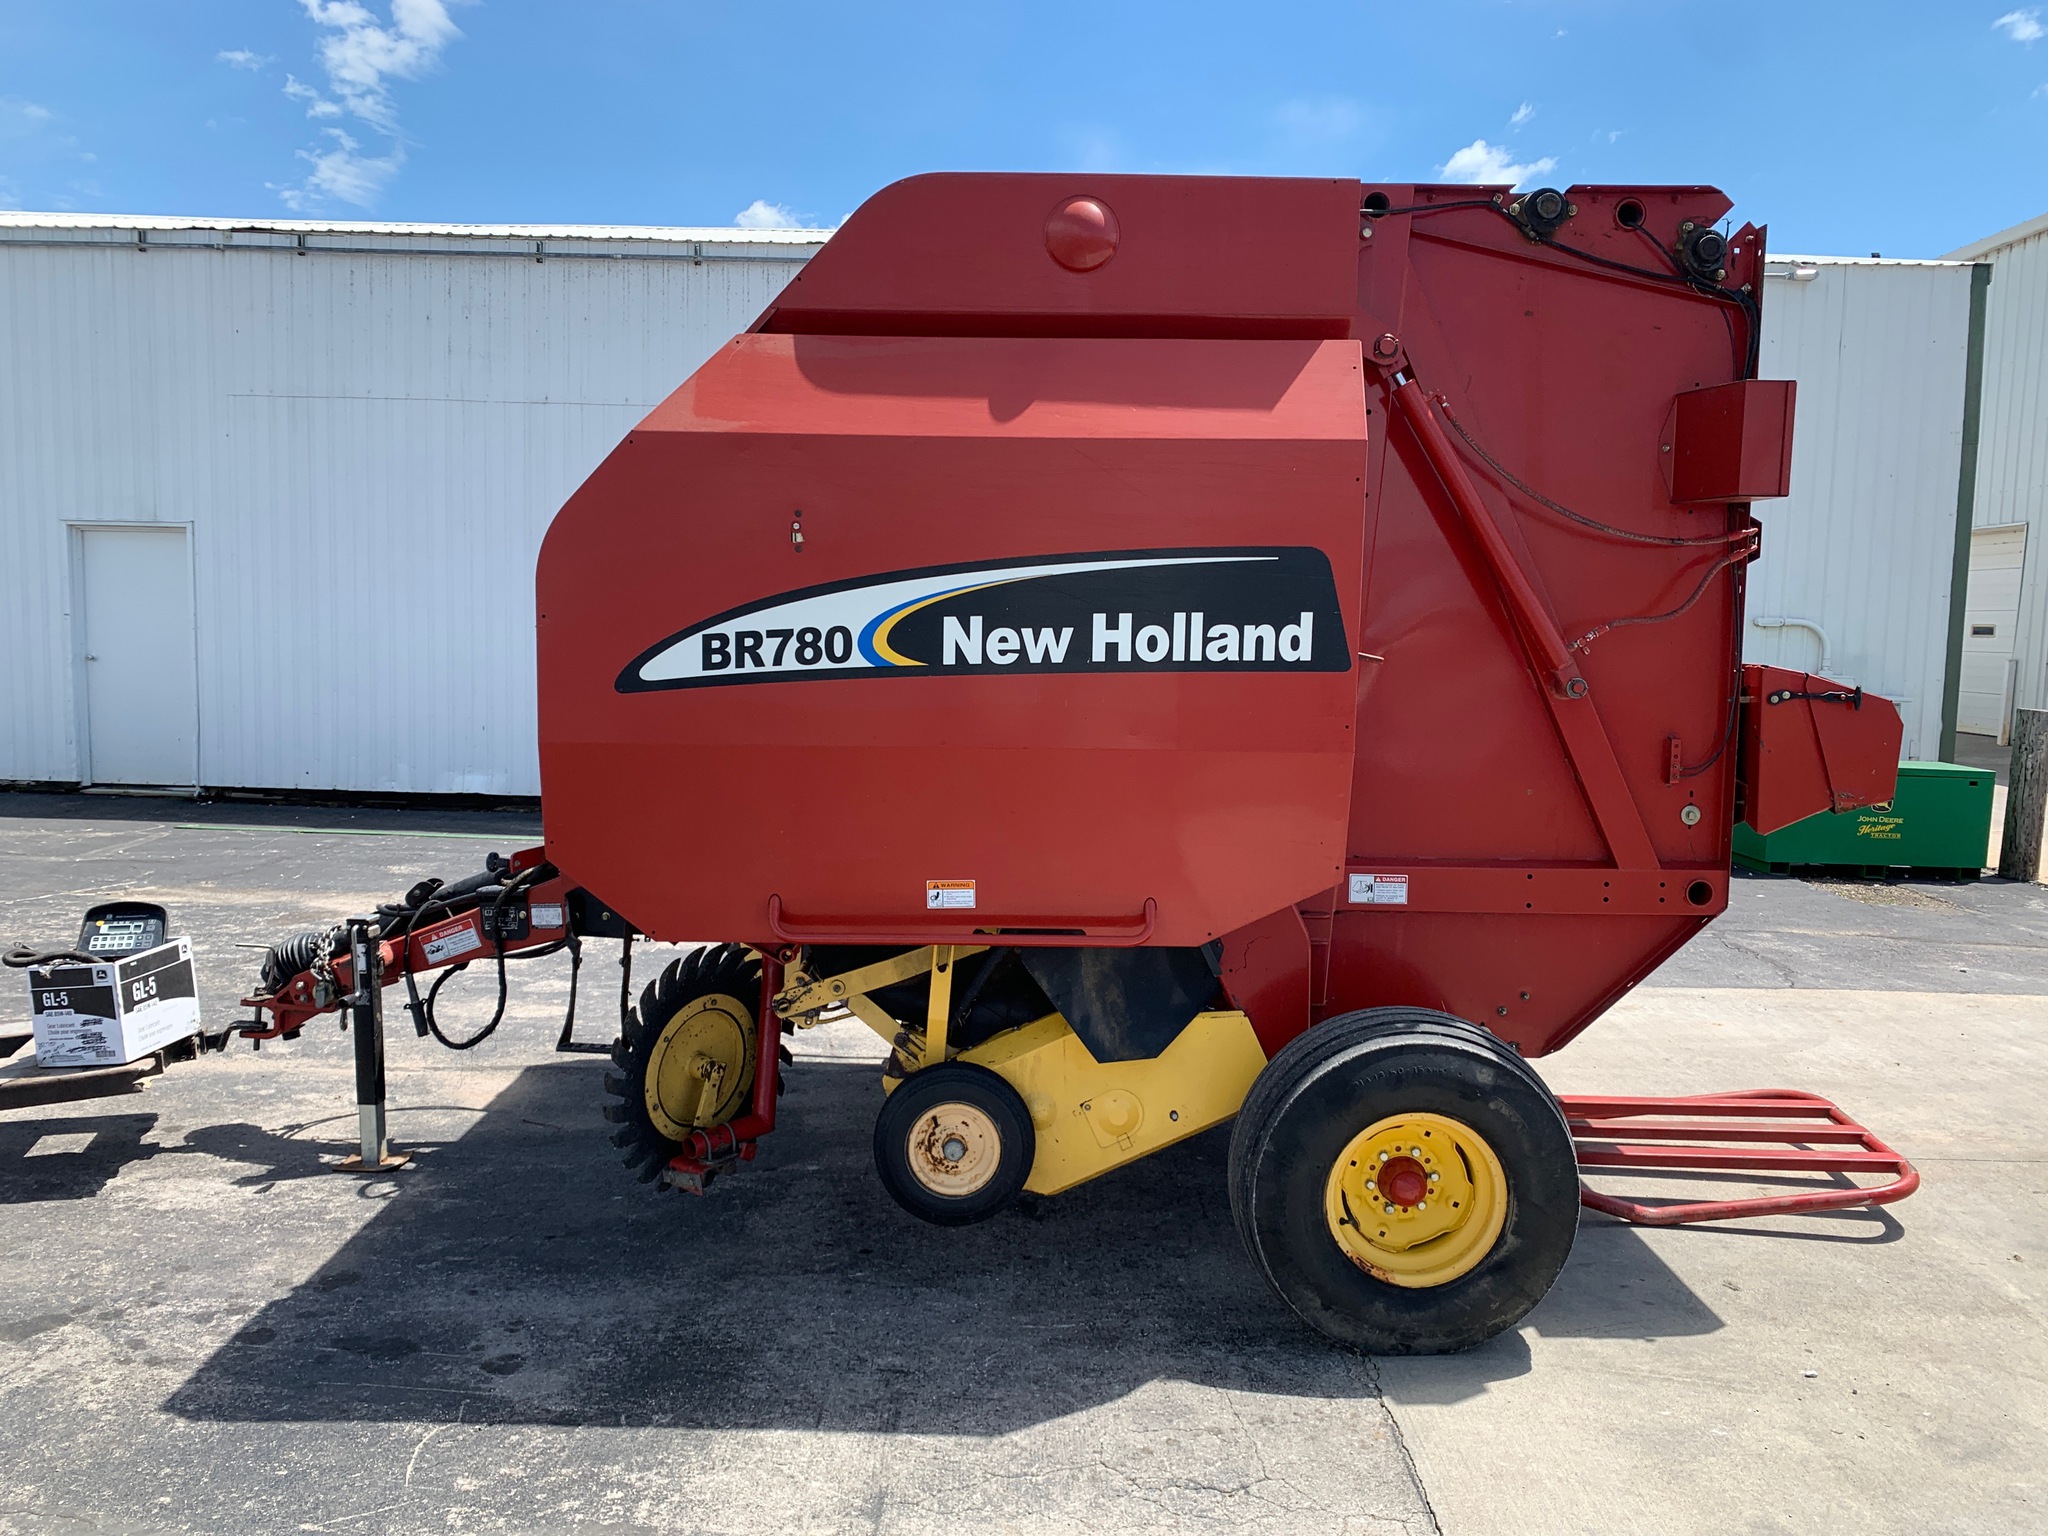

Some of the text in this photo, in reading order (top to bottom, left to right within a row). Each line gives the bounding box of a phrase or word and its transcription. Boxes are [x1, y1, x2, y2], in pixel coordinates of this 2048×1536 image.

[942, 611, 1313, 665] New Holland
[702, 625, 853, 671] BR780
[1857, 815, 1904, 824] JOHN DEERE
[1857, 824, 1896, 836] Heritage
[439, 925, 463, 938] DANGER
[132, 976, 157, 1001] GL-5
[42, 991, 69, 1007] GL-5
